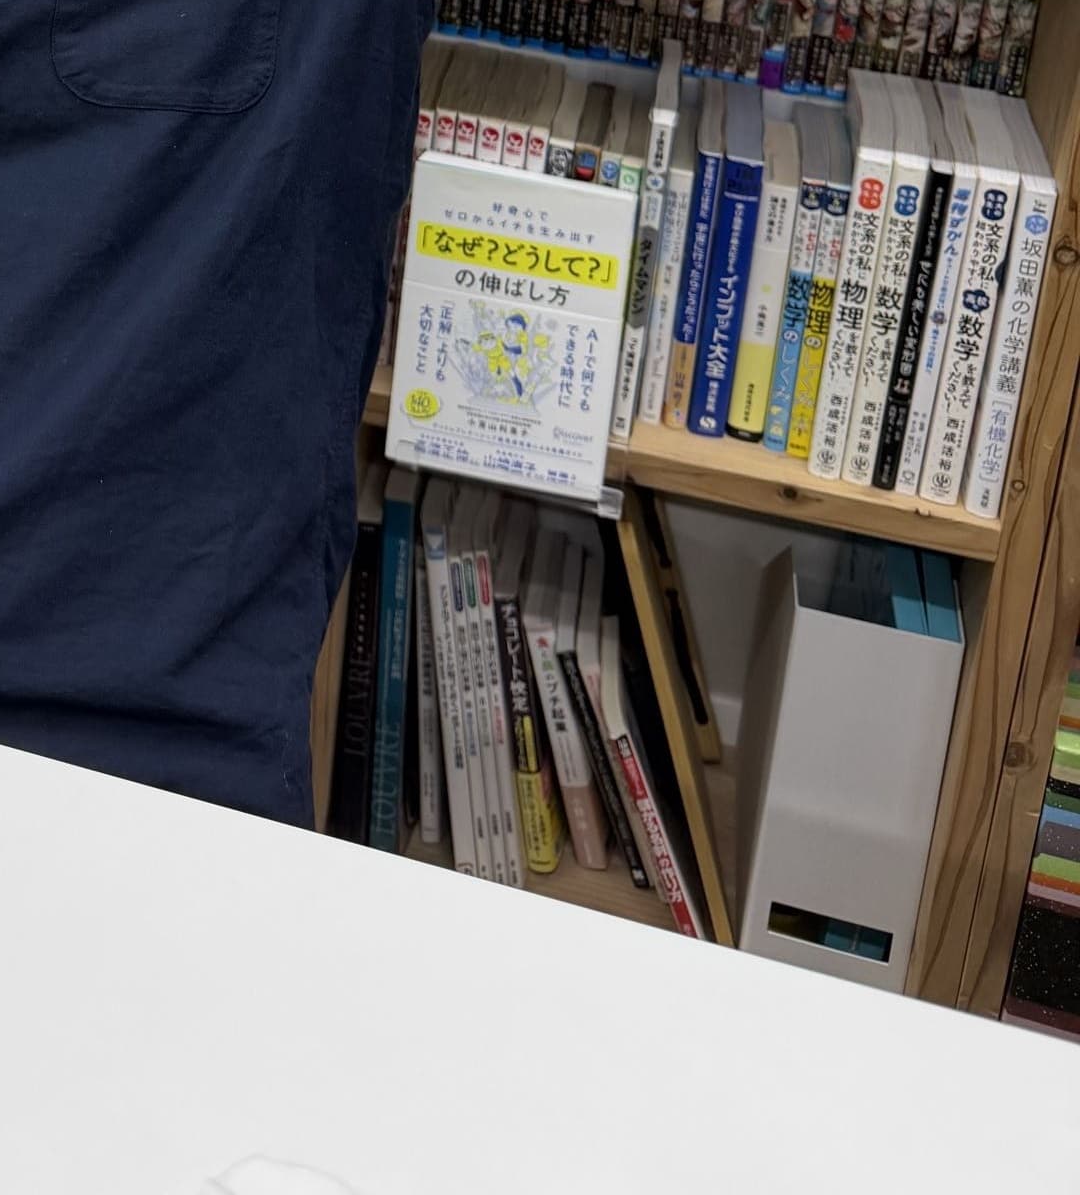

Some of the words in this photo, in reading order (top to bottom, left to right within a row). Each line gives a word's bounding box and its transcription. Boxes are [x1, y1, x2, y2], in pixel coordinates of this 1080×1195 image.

[444, 209, 595, 244] ゼロからイチを生み出す
[857, 213, 880, 280] 文系の私に
[892, 219, 915, 286] 文系の私に
[979, 222, 1005, 290] 文系の私に
[455, 268, 570, 305] の伸ばし方
[836, 279, 868, 331] 物理
[871, 284, 904, 336] 数学
[997, 238, 1044, 395] 坂田薫の化学講義
[415, 305, 434, 374] 大切なこと
[558, 324, 578, 409] できる時代に
[953, 314, 985, 361] 数学
[375, 721, 401, 838] LOUVRE
